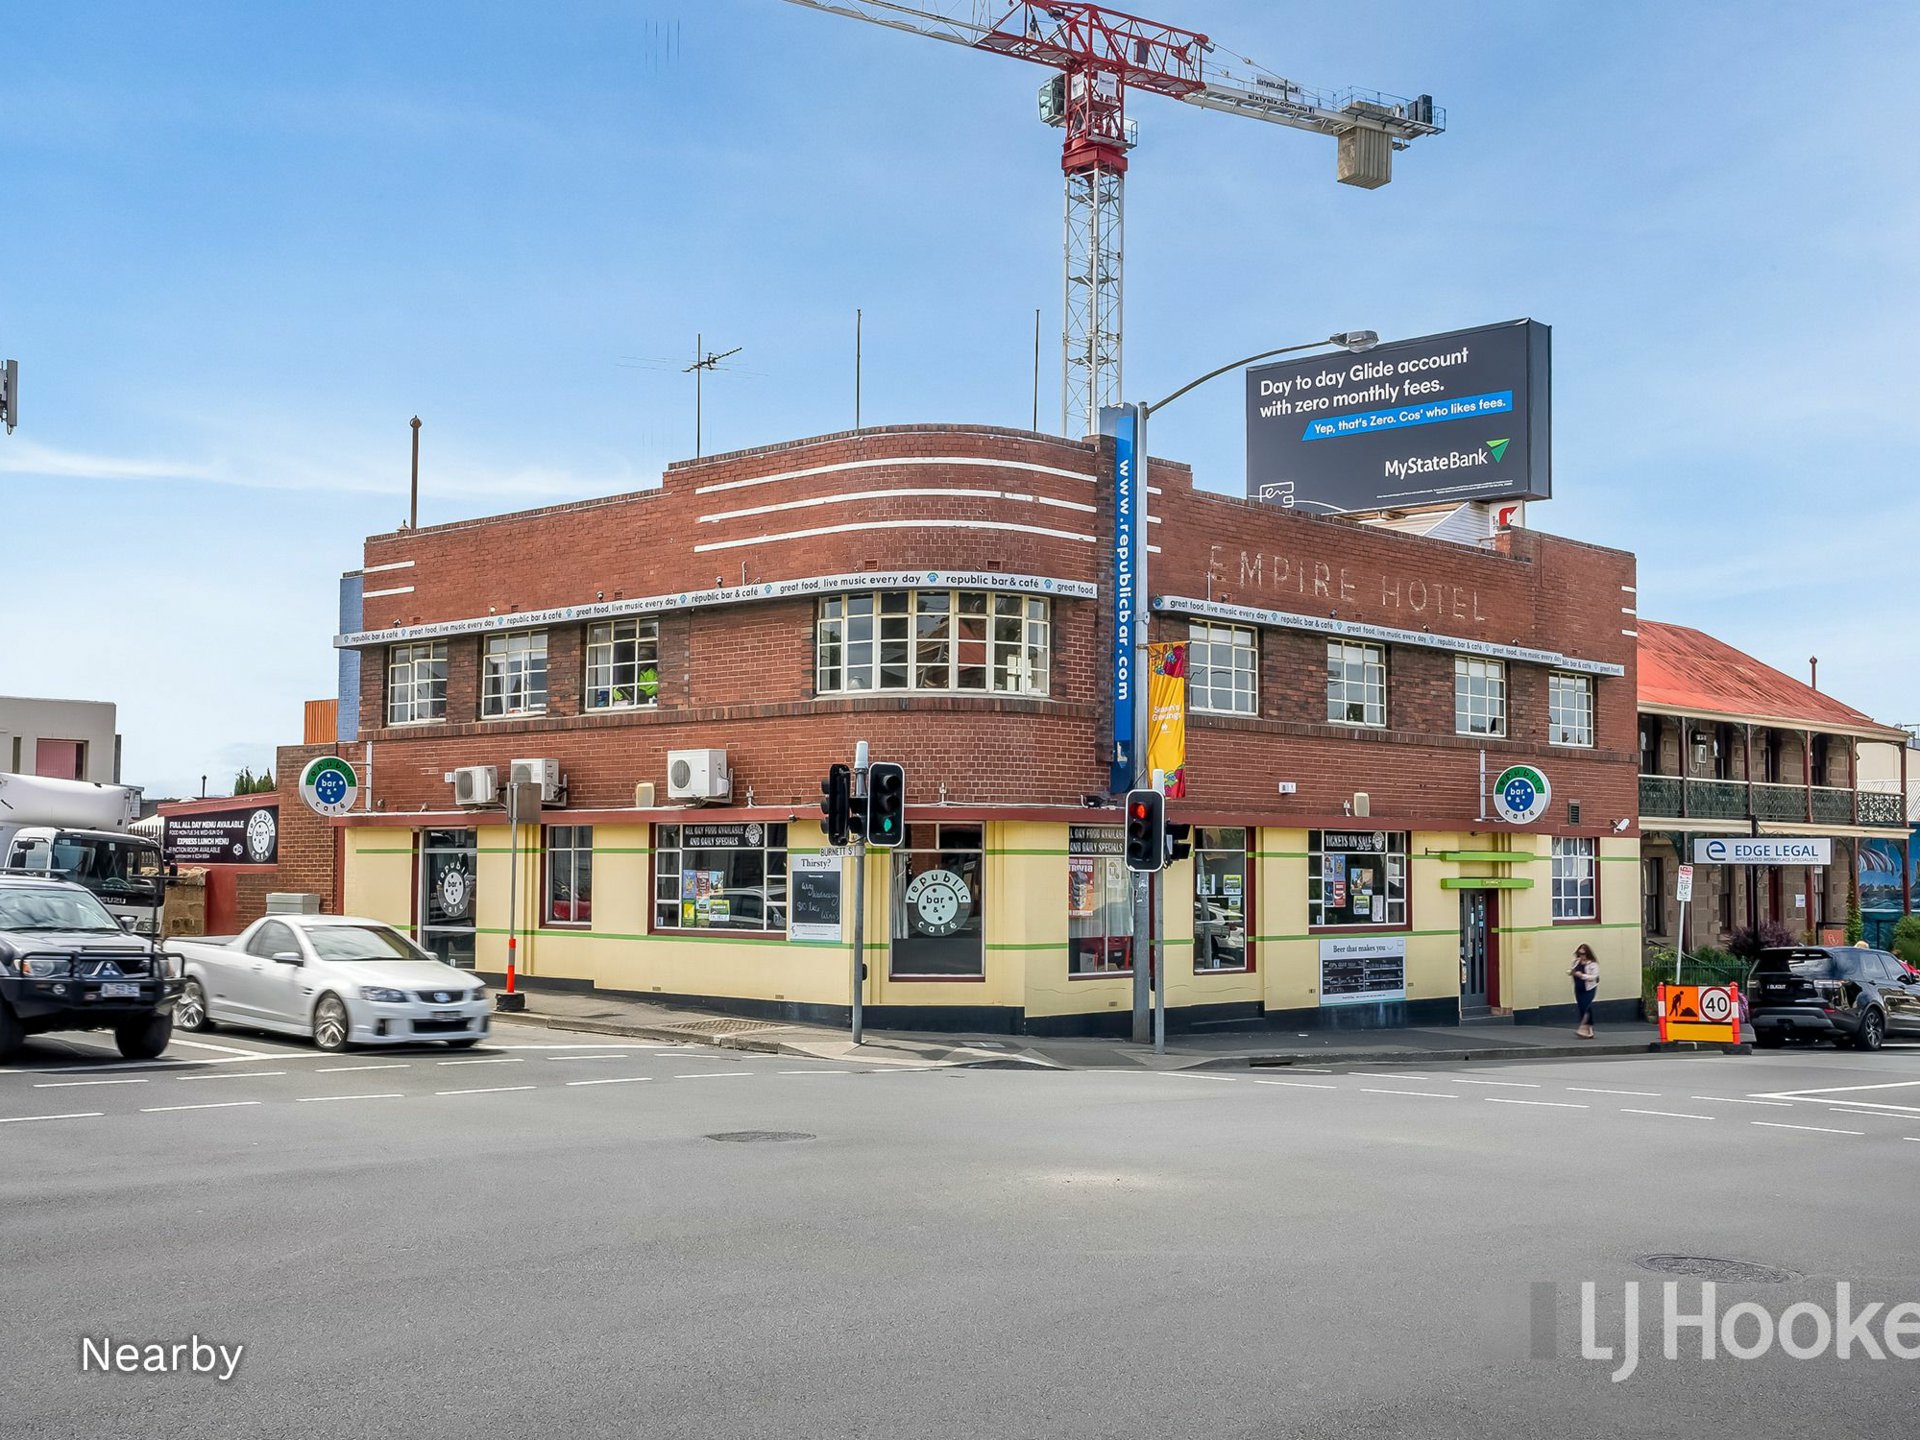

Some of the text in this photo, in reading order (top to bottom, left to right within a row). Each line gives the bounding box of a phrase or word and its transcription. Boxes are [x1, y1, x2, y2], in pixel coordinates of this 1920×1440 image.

[1260, 347, 1469, 397] Day to day Glide account
[1260, 377, 1445, 418] with zero monthly fees.
[1314, 396, 1506, 435] Yep, that's Zero. Cos' who likes fees.
[1384, 447, 1488, 479] MyStateBank
[1117, 459, 1131, 700] www.republicbar.com
[1210, 545, 1485, 621] EMPIRE HOTEL
[351, 635, 371, 644] republic
[371, 633, 380, 641] bar
[408, 627, 424, 638] great
[439, 624, 449, 632] live
[450, 622, 466, 632] music
[467, 621, 484, 631] every
[485, 619, 495, 628] day
[506, 614, 529, 626] republic
[530, 613, 541, 621] bar
[548, 609, 562, 619] café
[575, 607, 592, 618] great
[612, 604, 624, 612] live
[624, 601, 643, 611] music
[644, 598, 664, 610] every
[665, 597, 678, 607] day
[691, 591, 719, 604] republic
[720, 589, 733, 600] bar
[734, 588, 740, 598] &
[742, 585, 759, 598] café
[779, 584, 799, 595] great
[801, 580, 821, 591] food,
[823, 578, 838, 588] live
[840, 575, 867, 586] music
[869, 574, 899, 586] every
[901, 574, 921, 585] day
[946, 574, 989, 586] republic
[991, 575, 1008, 587] bar
[1009, 577, 1017, 587] &
[1018, 577, 1039, 589] café
[1056, 582, 1076, 593] great
[1169, 599, 1189, 609] great
[1206, 602, 1218, 613] live
[1219, 605, 1237, 615] music
[1238, 608, 1255, 619] every
[1256, 610, 1268, 622] day
[1280, 614, 1303, 626] republic
[1303, 617, 1315, 627] bar
[1346, 624, 1361, 634] great
[1386, 630, 1401, 639] music
[1402, 632, 1417, 642] every
[1417, 635, 1427, 643] day
[1457, 640, 1467, 649] bar
[321, 779, 337, 787] bar
[1510, 787, 1525, 796] bar
[315, 801, 346, 812] café
[1505, 809, 1535, 820] café
[169, 820, 245, 829] FULL ALL DAY MENU AVAILABLE
[247, 811, 276, 836] republic
[177, 837, 230, 845] EXPRESS LUNCH MENU
[1325, 834, 1349, 848] TICKETS
[1349, 835, 1357, 848] ON
[820, 847, 846, 857] BURNETT
[1735, 845, 1771, 857] EDGE
[1775, 845, 1819, 857] LEGAL
[800, 857, 832, 870] Thirsty?
[438, 861, 470, 886] republic
[908, 873, 968, 902] republic
[100, 896, 127, 905] SUZU
[926, 895, 945, 904] bar
[918, 921, 957, 934] café
[1333, 944, 1386, 953] Beer that makes you
[1704, 996, 1728, 1013] 40
